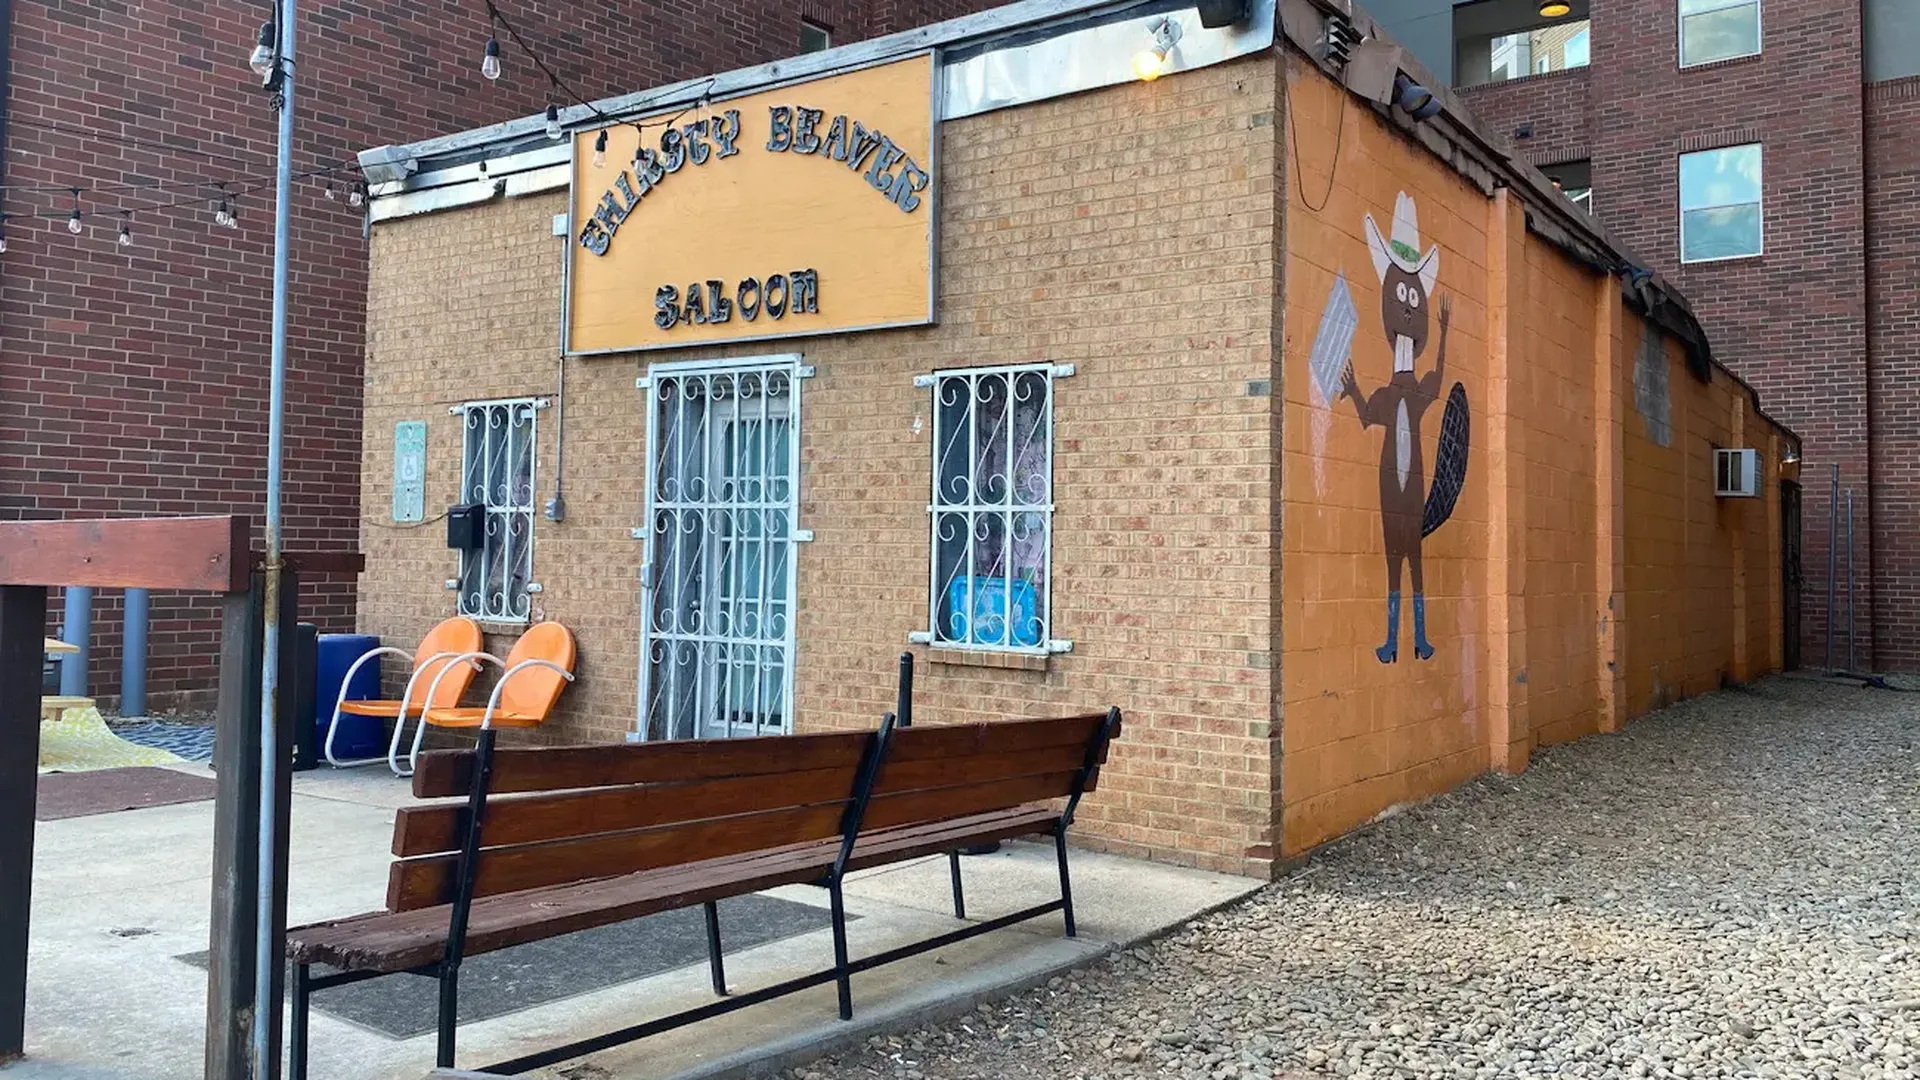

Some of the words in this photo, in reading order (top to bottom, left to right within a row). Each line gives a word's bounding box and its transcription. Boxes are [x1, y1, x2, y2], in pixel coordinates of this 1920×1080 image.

[579, 109, 740, 256] THIRSTY
[766, 105, 930, 213] BEAVER
[654, 268, 819, 330] SALOON
